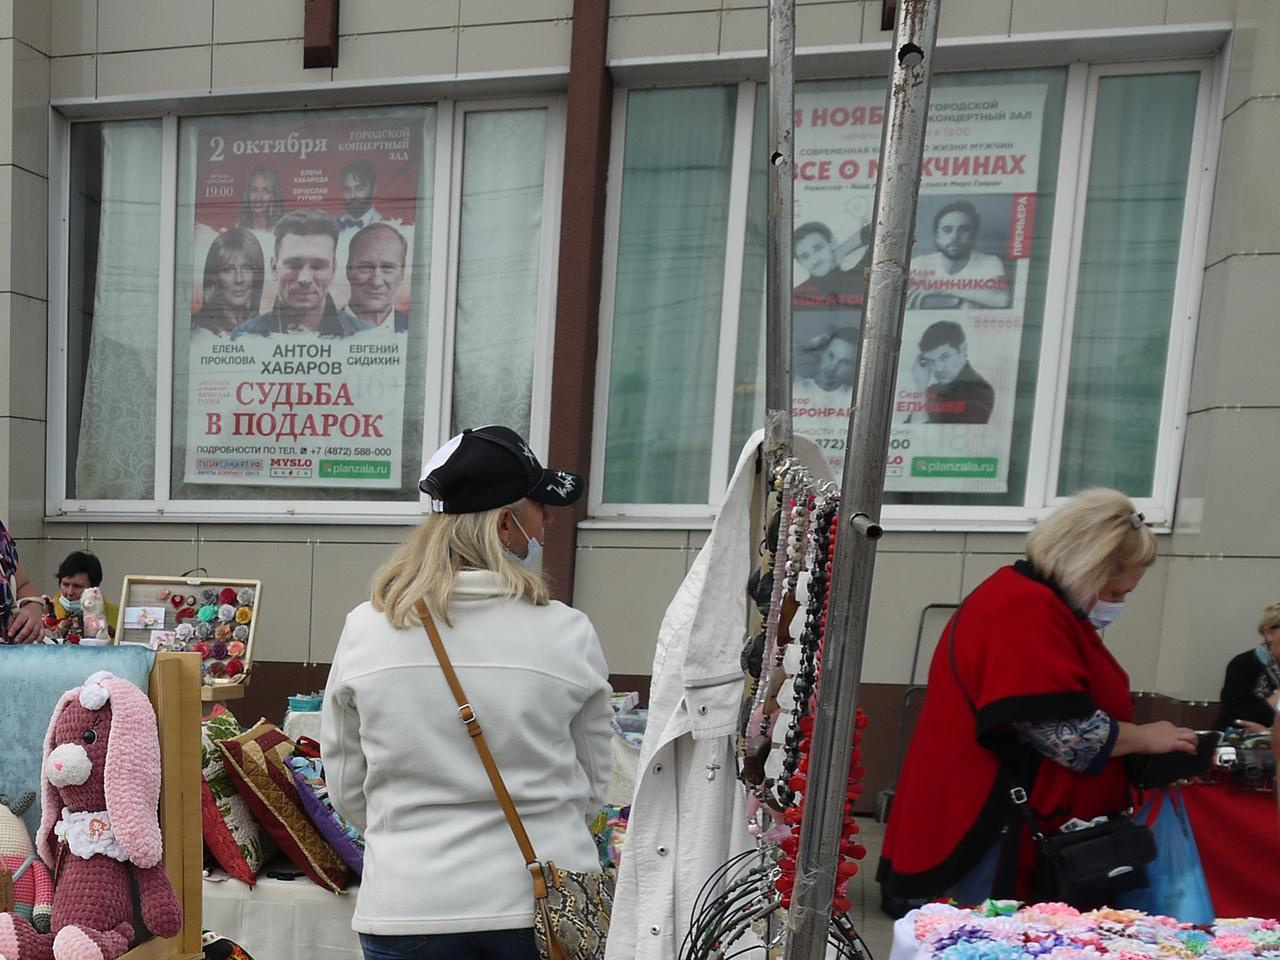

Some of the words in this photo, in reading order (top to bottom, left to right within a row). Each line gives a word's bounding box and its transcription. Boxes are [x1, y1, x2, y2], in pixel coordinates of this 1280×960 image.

[811, 106, 884, 128] НОЯБ
[928, 110, 1007, 123] КОНЦЕРТНЫЙ
[1008, 111, 1032, 120] ЗАЛ
[350, 126, 411, 141] ГОРОДСКОЙ
[209, 136, 225, 162] 2
[232, 131, 329, 160] октября
[338, 139, 410, 152] КОНЦЕРТНЫЙ
[838, 159, 860, 180] О
[204, 186, 234, 198] 19:00
[1013, 195, 1029, 256] ПРЕМЬЕРА
[212, 344, 245, 354] ЕЛЕНА
[272, 344, 332, 358] АНТОН
[349, 343, 400, 354] ЕВГЕНИЙ
[200, 356, 256, 365] ПРОКЛОВА
[347, 356, 401, 366] СИДИХИН
[260, 361, 343, 375] ХАБАРОВ
[235, 381, 355, 412] СУДЬБА
[205, 412, 222, 435] В
[232, 412, 384, 443] ПОДАРОК
[196, 445, 261, 455] ПОДРОБНОСТИ
[278, 447, 297, 455] ТЕЛ.
[324, 447, 352, 456] (4872)
[354, 447, 392, 457] 588-000
[270, 458, 313, 468] MYSLO
[332, 462, 388, 474] planzala.ru
